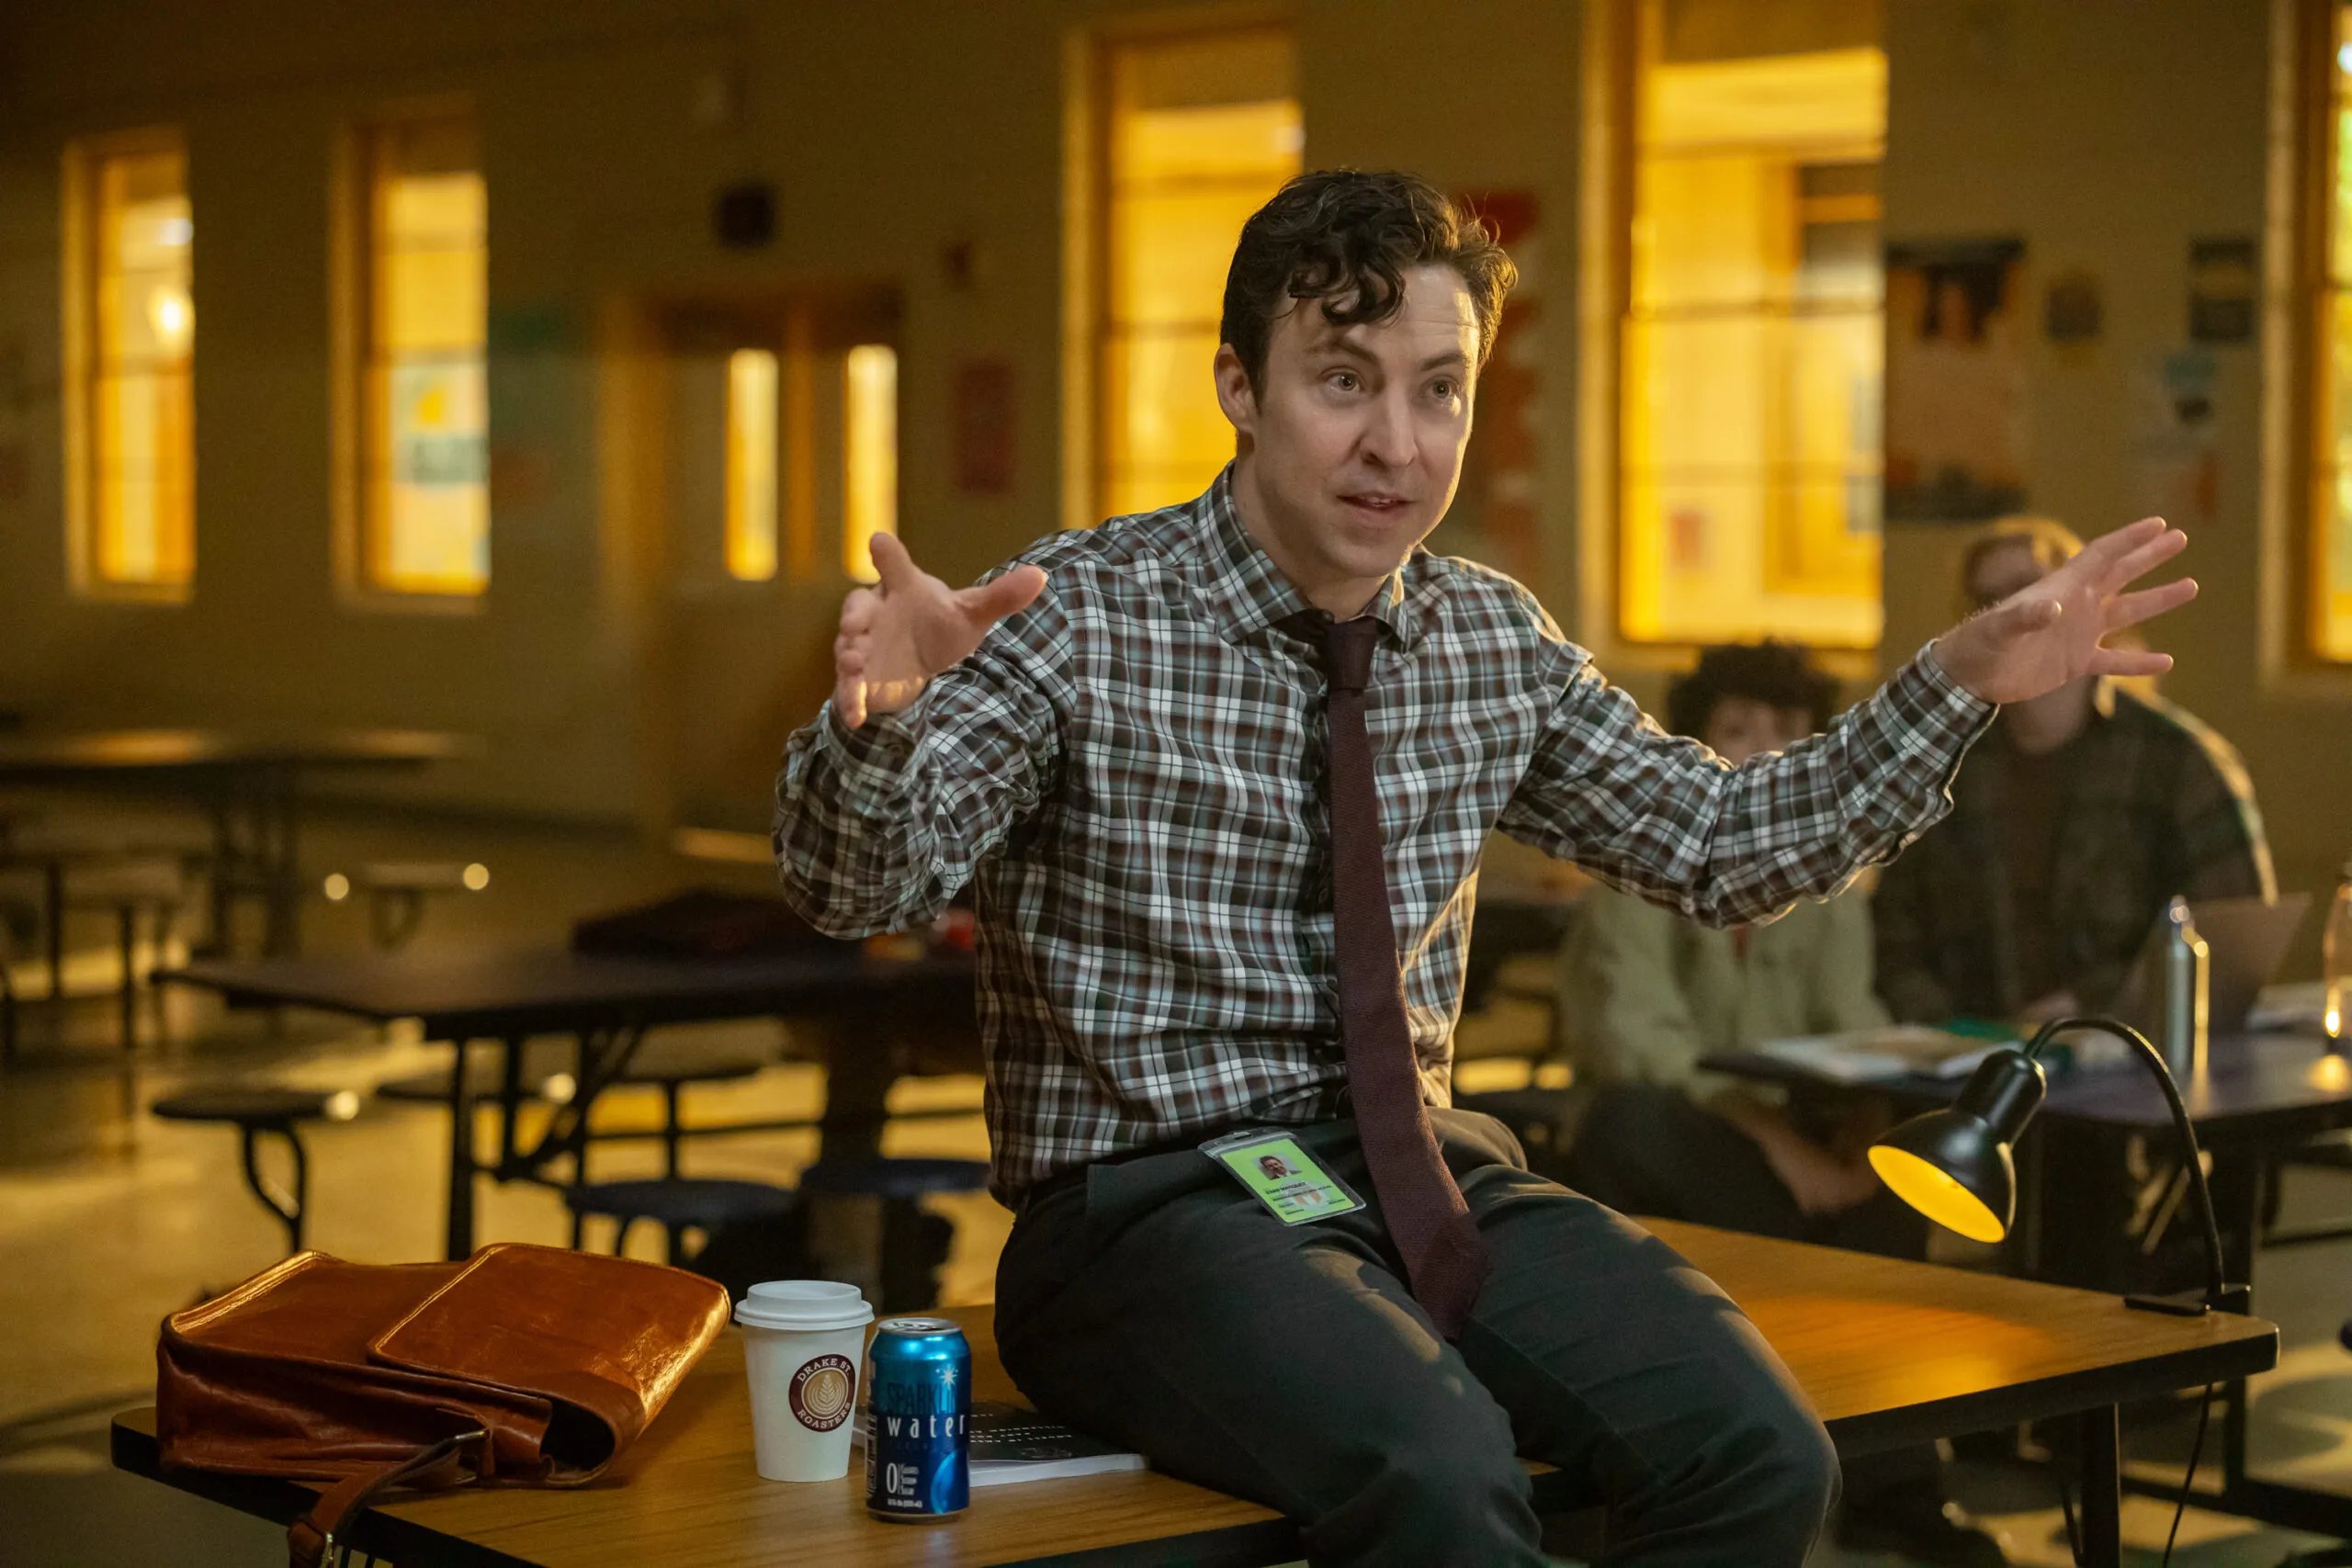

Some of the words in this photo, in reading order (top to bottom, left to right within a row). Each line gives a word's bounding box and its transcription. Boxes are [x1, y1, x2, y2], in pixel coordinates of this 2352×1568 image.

[797, 1358, 838, 1382] DRAKE
[840, 1360, 851, 1376] ST.
[797, 1402, 851, 1429] ROASTERS
[887, 1414, 966, 1439] water
[886, 1462, 898, 1494] 0
